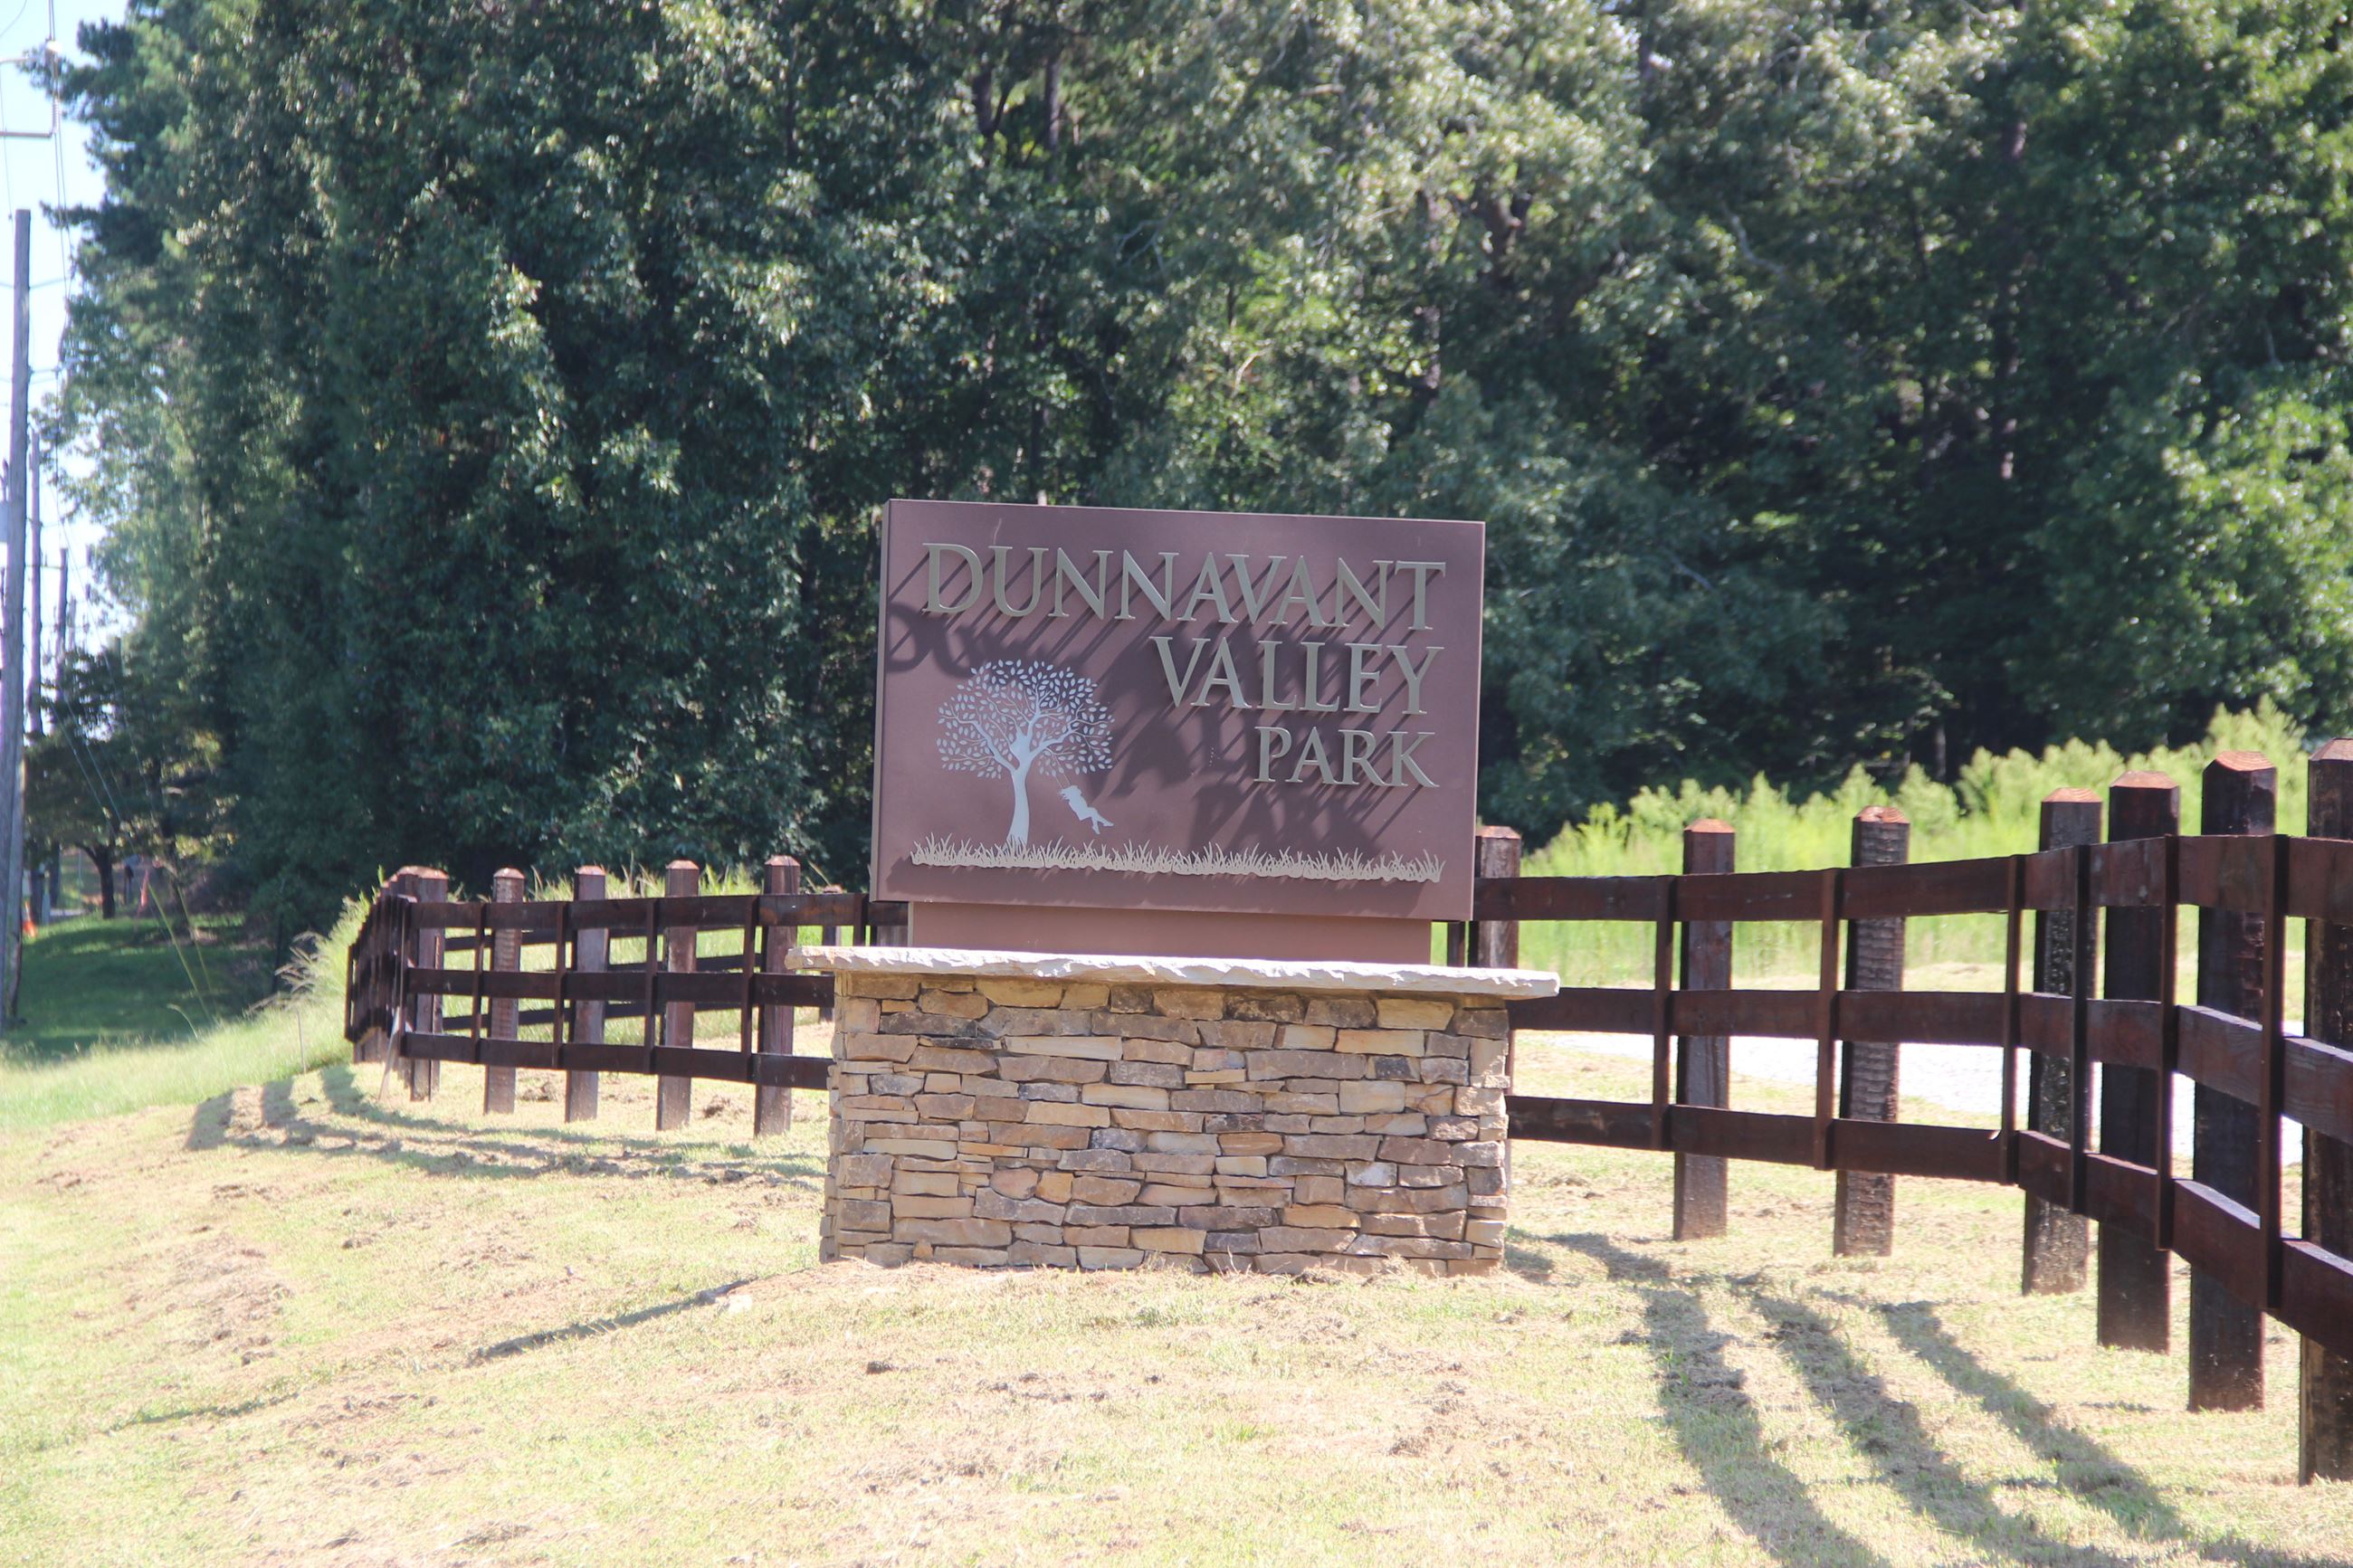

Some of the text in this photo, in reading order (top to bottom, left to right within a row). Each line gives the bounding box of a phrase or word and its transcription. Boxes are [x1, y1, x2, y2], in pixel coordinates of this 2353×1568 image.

[921, 543, 1446, 631] DUNNAVANT
[1149, 636, 1444, 715] VALLEY
[1254, 726, 1440, 788] PARK
